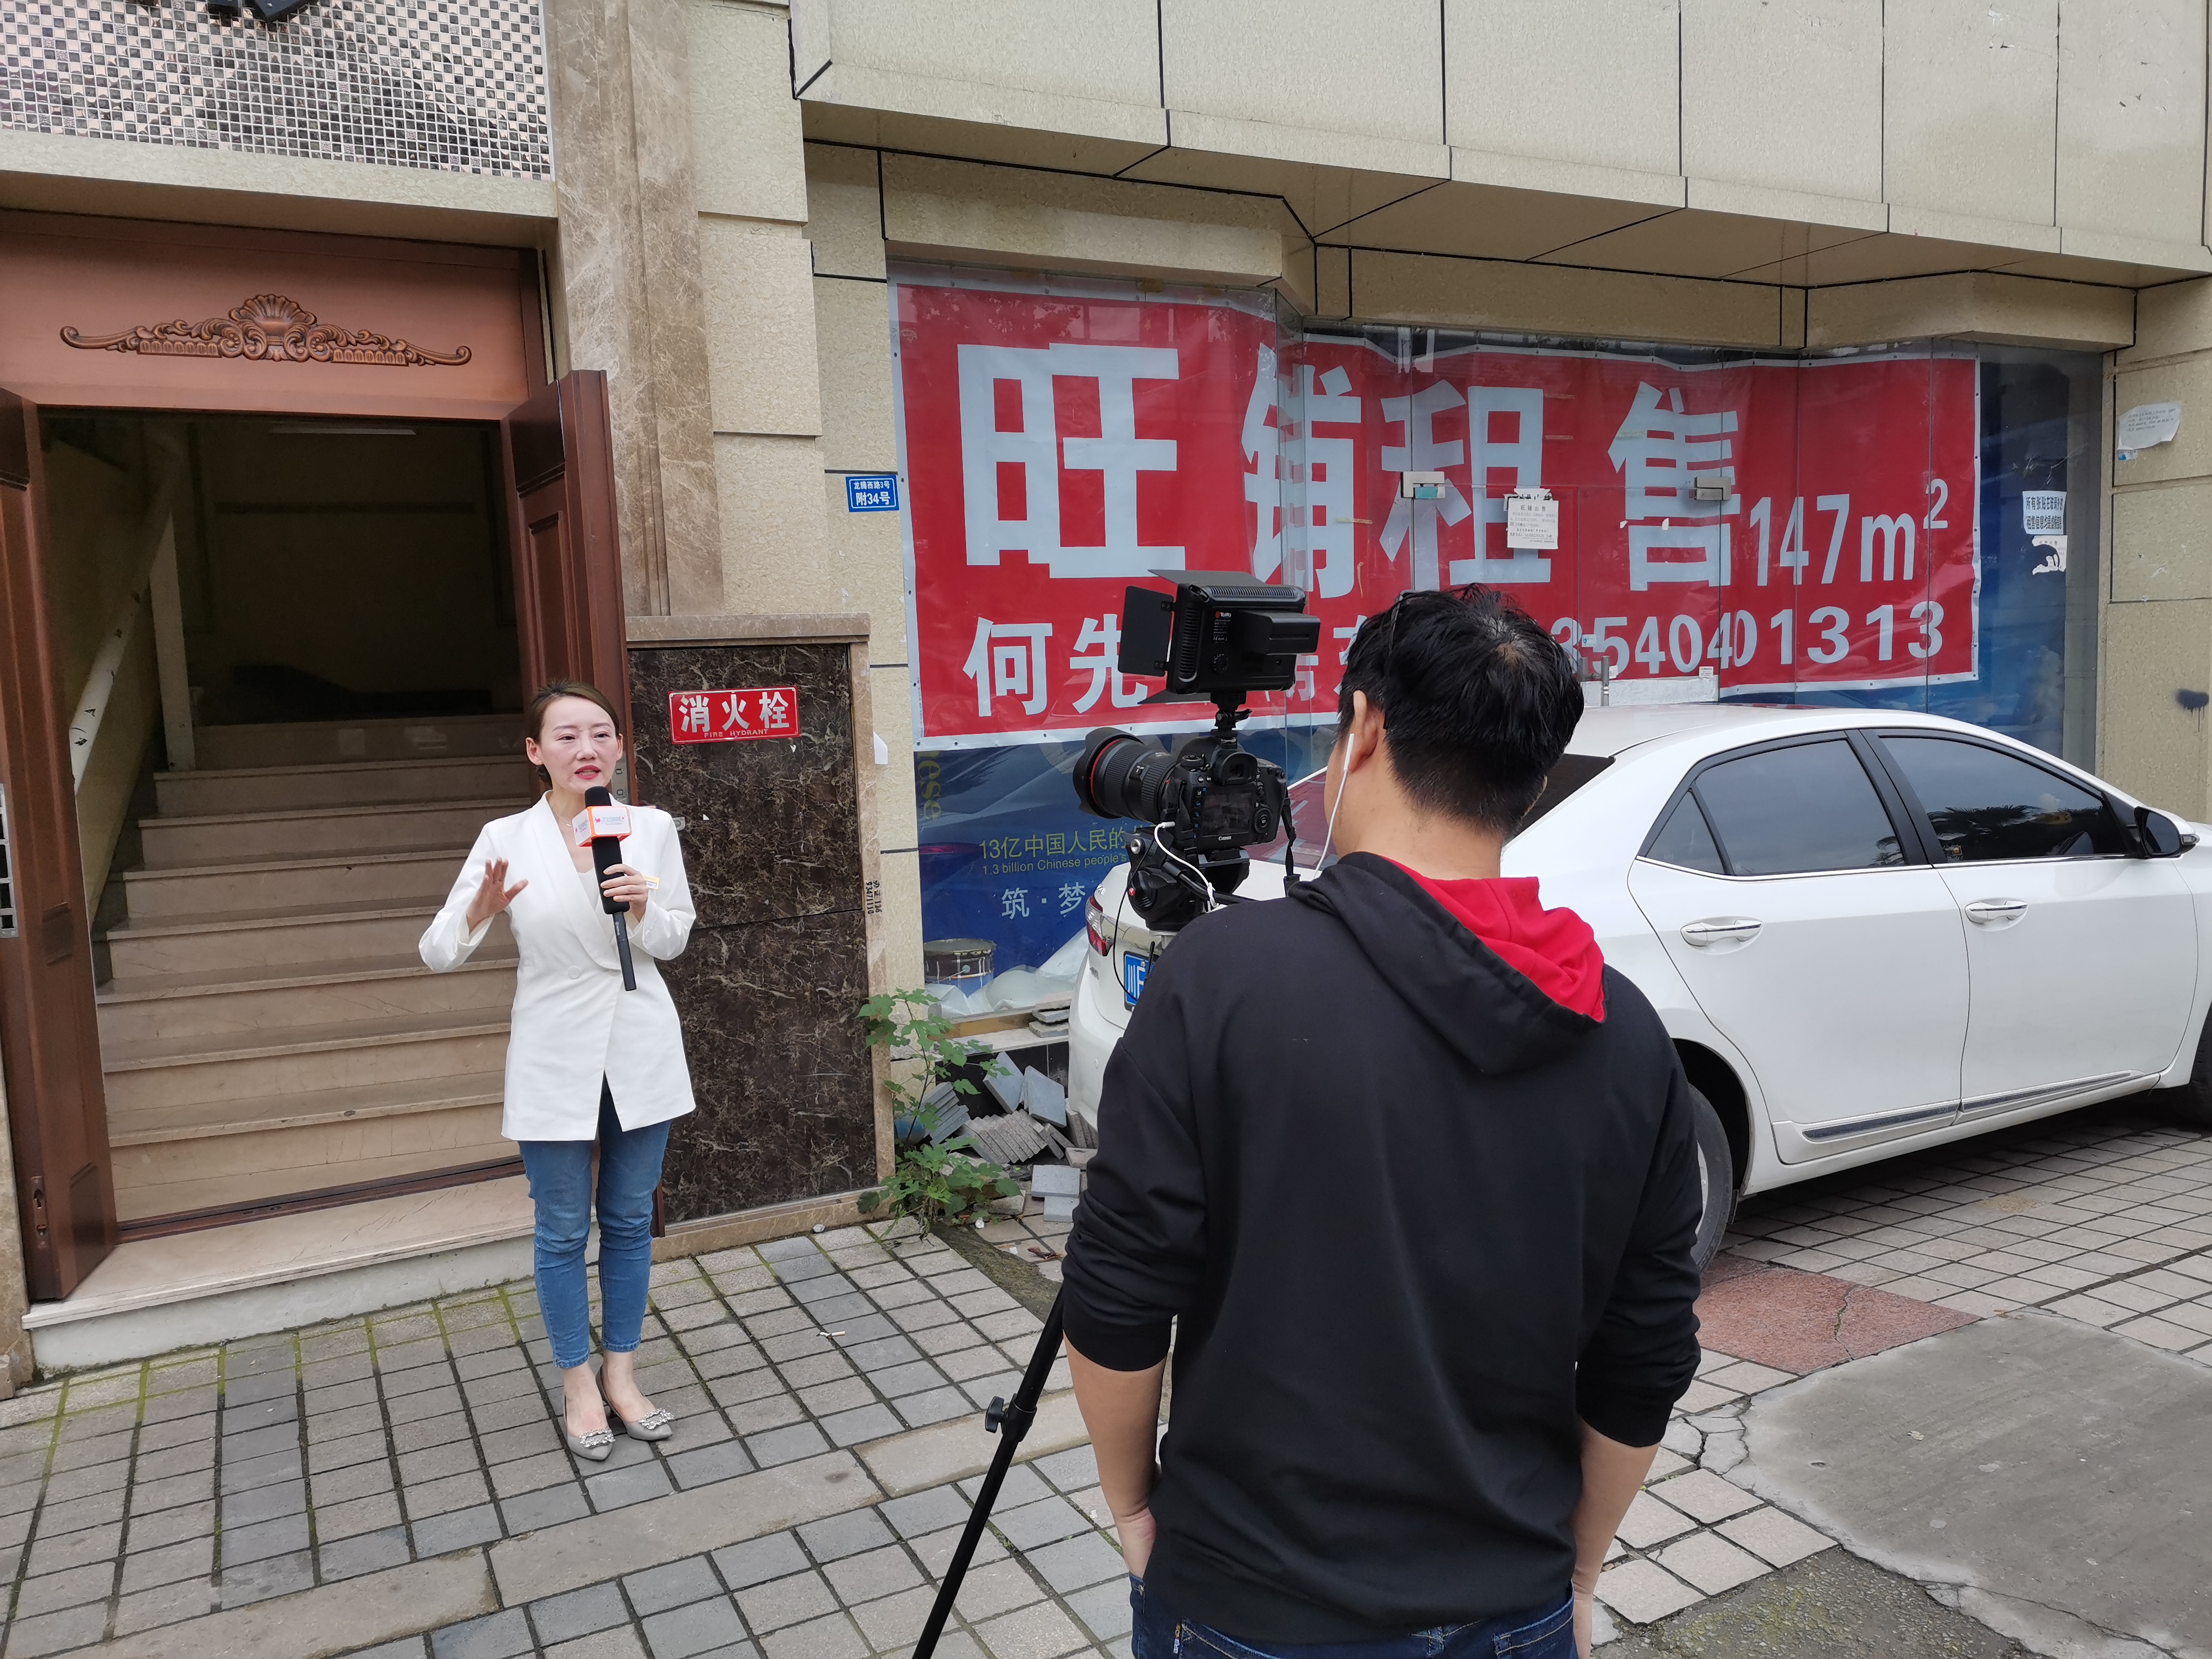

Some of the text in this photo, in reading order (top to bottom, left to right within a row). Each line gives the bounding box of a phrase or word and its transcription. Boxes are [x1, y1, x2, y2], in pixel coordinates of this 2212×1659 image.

[853, 481, 890, 489] 龙腾西路3号
[855, 492, 891, 505] 附34号
[679, 692, 790, 733] 消火栓
[979, 825, 1157, 859] 13亿中国人民的
[1002, 862, 1034, 873] billion
[1037, 858, 1081, 871] Chinese
[1084, 853, 1127, 868] people's
